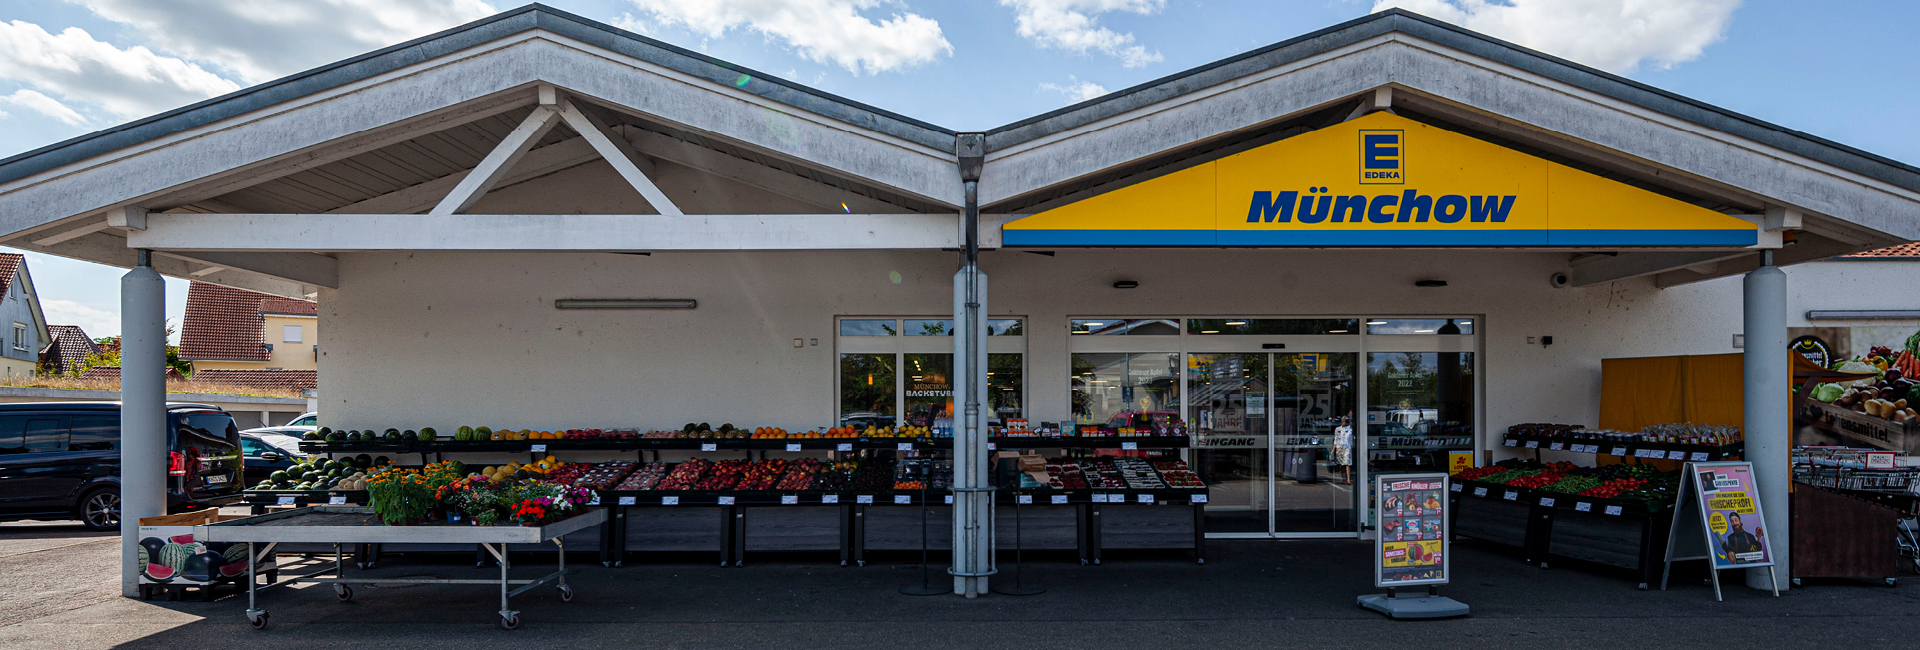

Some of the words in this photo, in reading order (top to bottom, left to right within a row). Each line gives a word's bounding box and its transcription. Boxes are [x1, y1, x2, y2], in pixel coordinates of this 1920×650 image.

[1364, 134, 1399, 169] E
[1364, 171, 1400, 179] EDEKA
[1246, 186, 1517, 224] Münchow
[1212, 393, 1242, 418] 25
[1300, 393, 1329, 418] 25
[1213, 417, 1242, 428] JAHRE
[1825, 410, 1891, 444] Lebensmittel.
[1197, 438, 1256, 446] EINGANG
[1393, 482, 1410, 490] FRISCHE
[1710, 499, 1751, 509] FRISCHEPROFI
